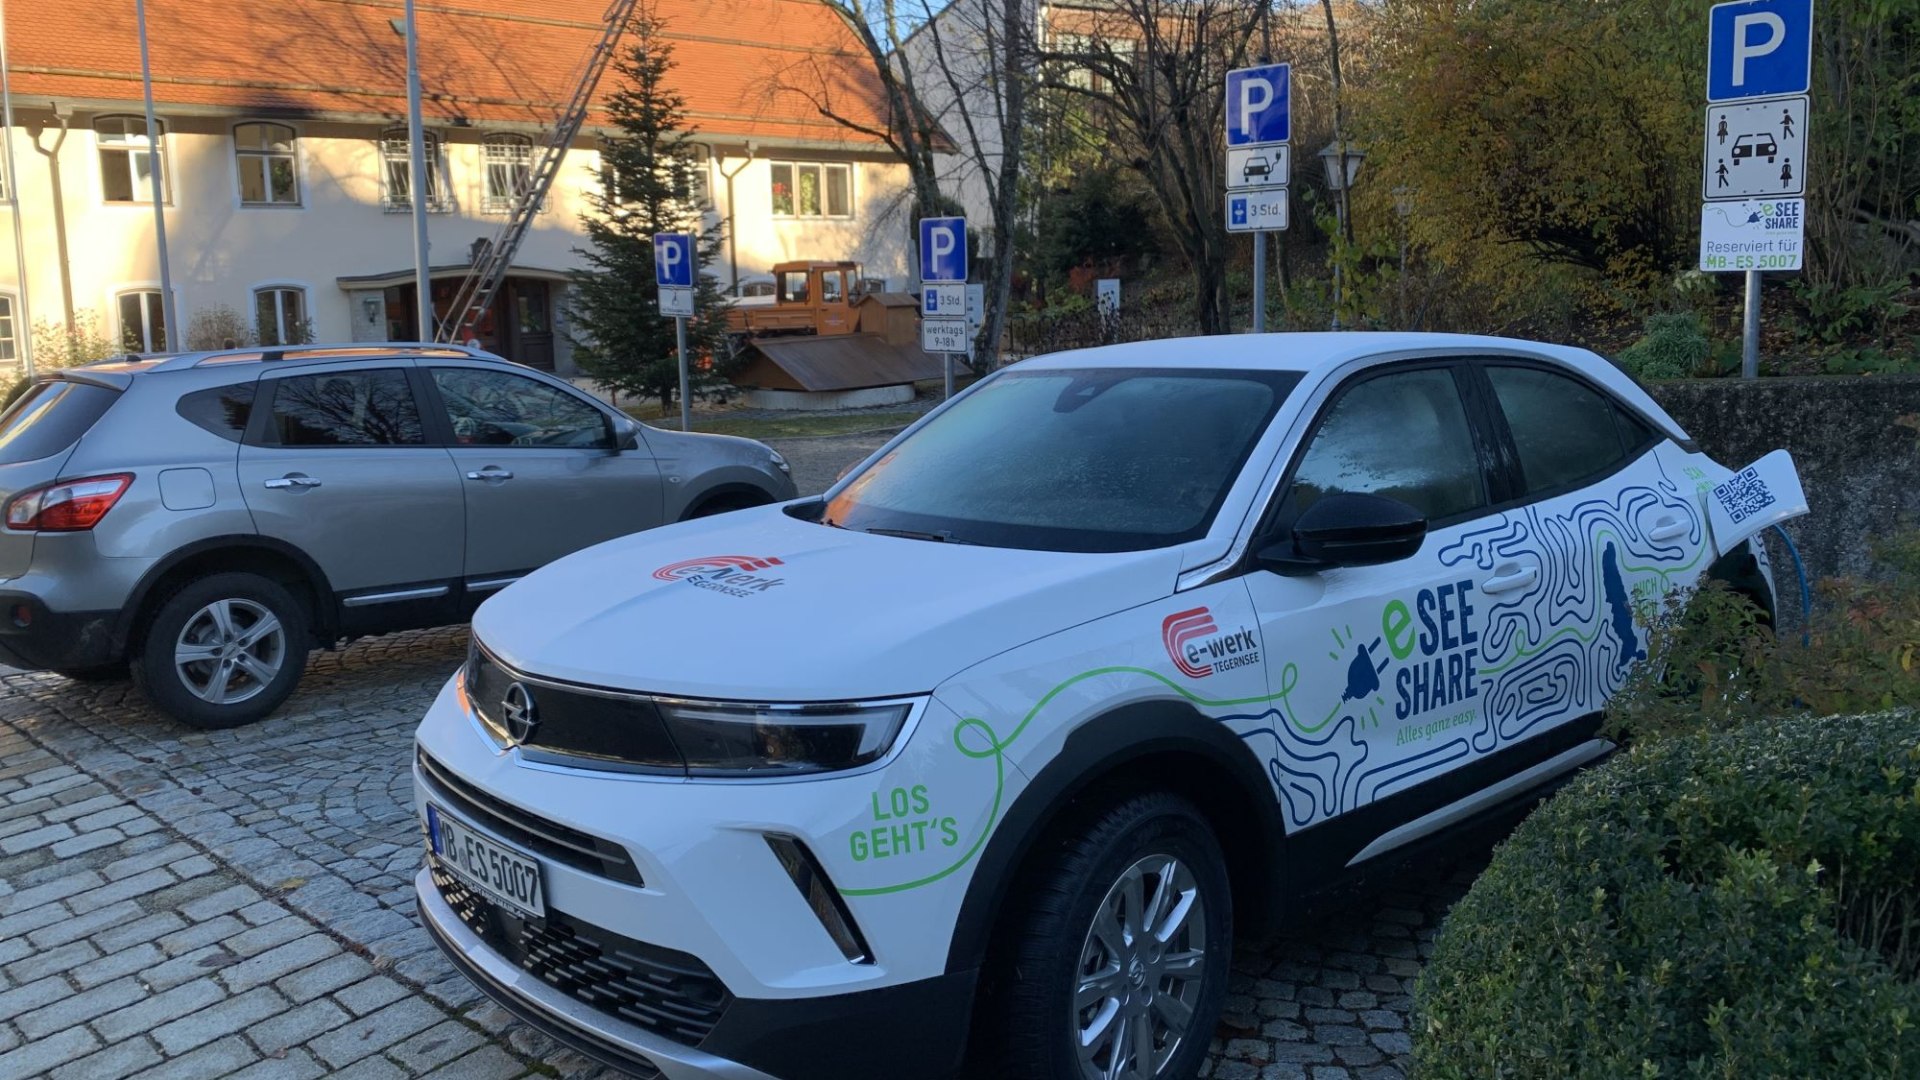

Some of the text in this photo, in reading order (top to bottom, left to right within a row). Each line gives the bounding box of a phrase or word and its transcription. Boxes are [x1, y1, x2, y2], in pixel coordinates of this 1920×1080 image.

[1732, 11, 1786, 87] P
[1241, 77, 1274, 136] P
[1250, 203, 1281, 216] 3 Std.
[1764, 217, 1799, 230] SHARE
[662, 240, 682, 279] P
[931, 226, 955, 273] P
[1706, 239, 1798, 253] Reserviert für
[1706, 254, 1797, 269] MB-ES 5007
[940, 295, 945, 306] 3
[926, 325, 964, 338] werktags
[1185, 625, 1257, 664] e-werk
[1213, 651, 1260, 674] TEGERNSEE
[1395, 647, 1478, 720] SHARE
[1396, 725, 1424, 747] Alles
[1425, 717, 1451, 741] ganz
[871, 784, 930, 821] LOS
[464, 834, 489, 883] ES
[488, 847, 538, 908] 5007
